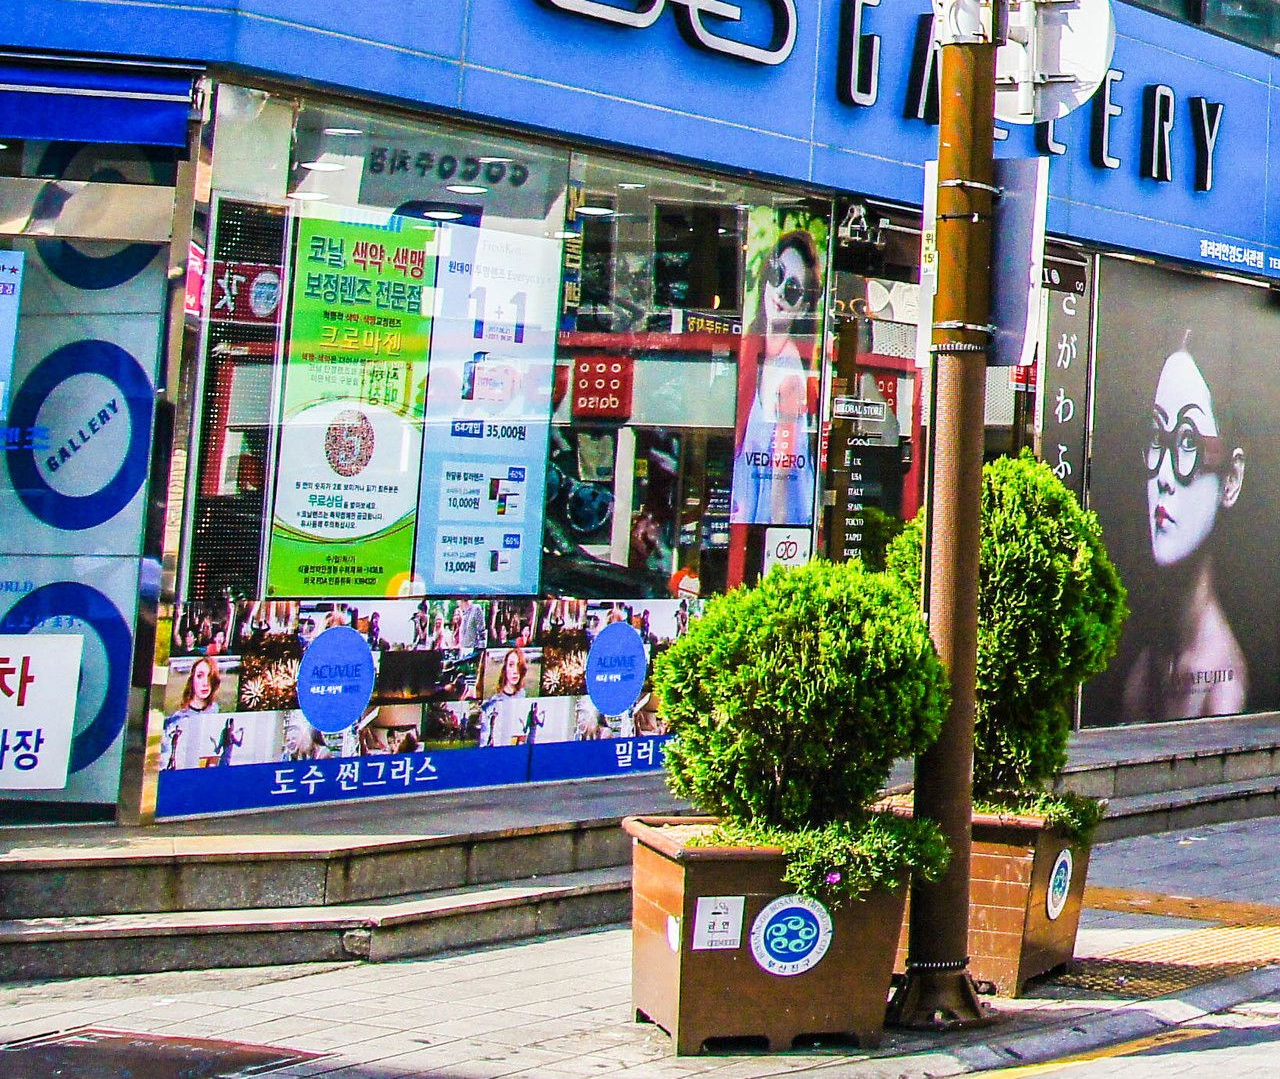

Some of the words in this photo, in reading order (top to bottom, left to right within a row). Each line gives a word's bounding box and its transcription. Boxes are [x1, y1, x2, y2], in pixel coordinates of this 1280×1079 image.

[304, 272, 373, 307] 보정렌즈
[375, 280, 423, 314] 전문점
[319, 325, 402, 358] 크로마젠
[45, 398, 121, 474] GALLERY
[486, 423, 527, 441] 35,000원
[270, 767, 325, 796] 도수
[335, 756, 439, 790] 썬그라스
